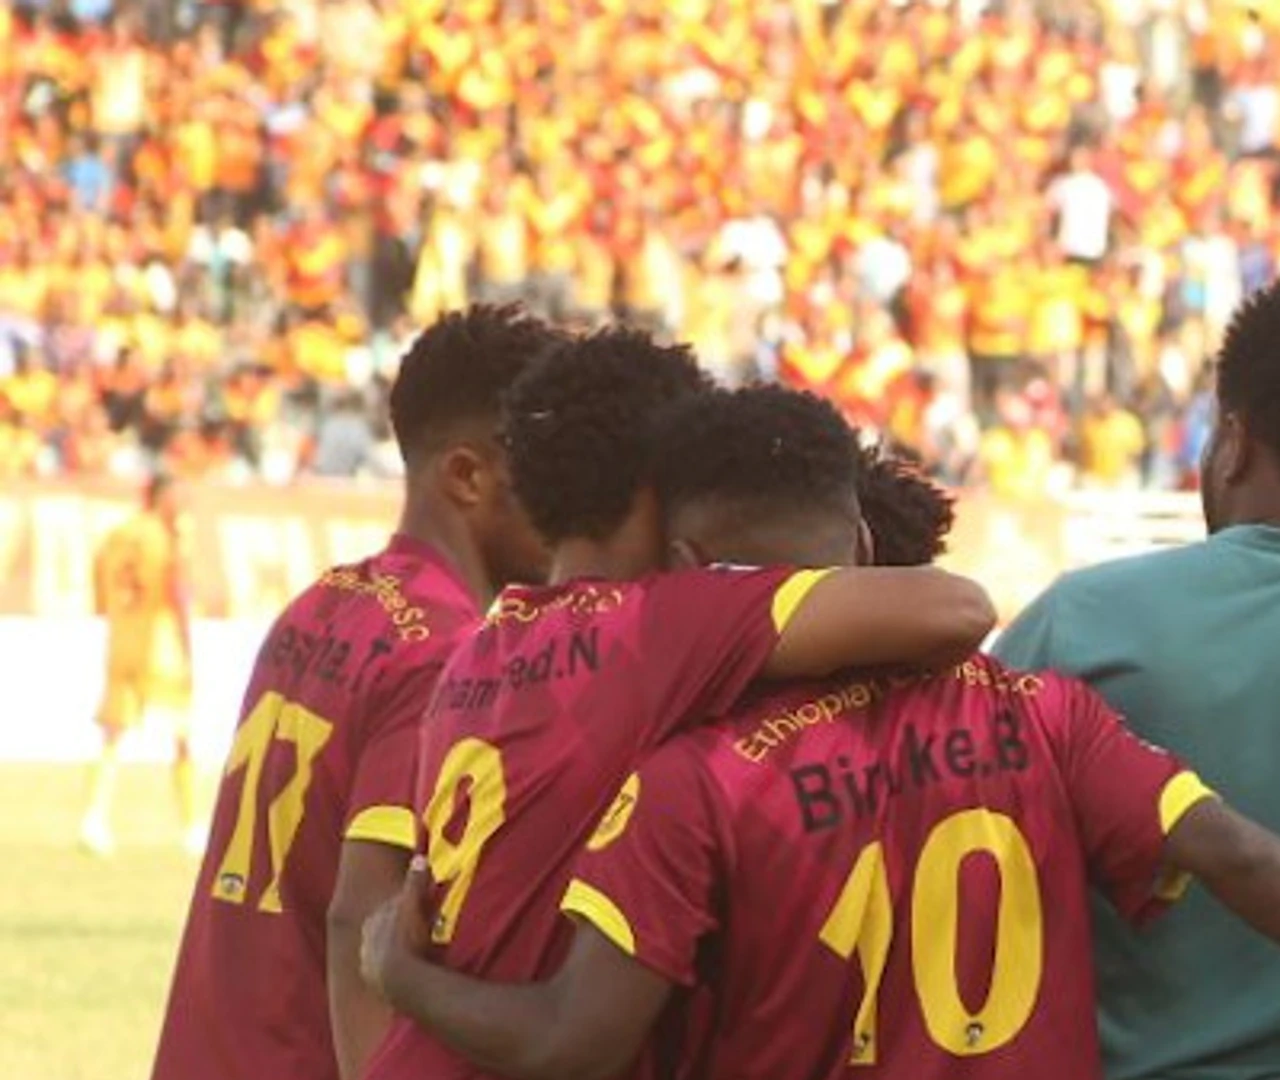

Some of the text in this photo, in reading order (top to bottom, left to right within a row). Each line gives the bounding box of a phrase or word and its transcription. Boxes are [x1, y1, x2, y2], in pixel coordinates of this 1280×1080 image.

[211, 690, 334, 914] 17
[422, 736, 508, 945] 9
[818, 807, 1044, 1065] 10
